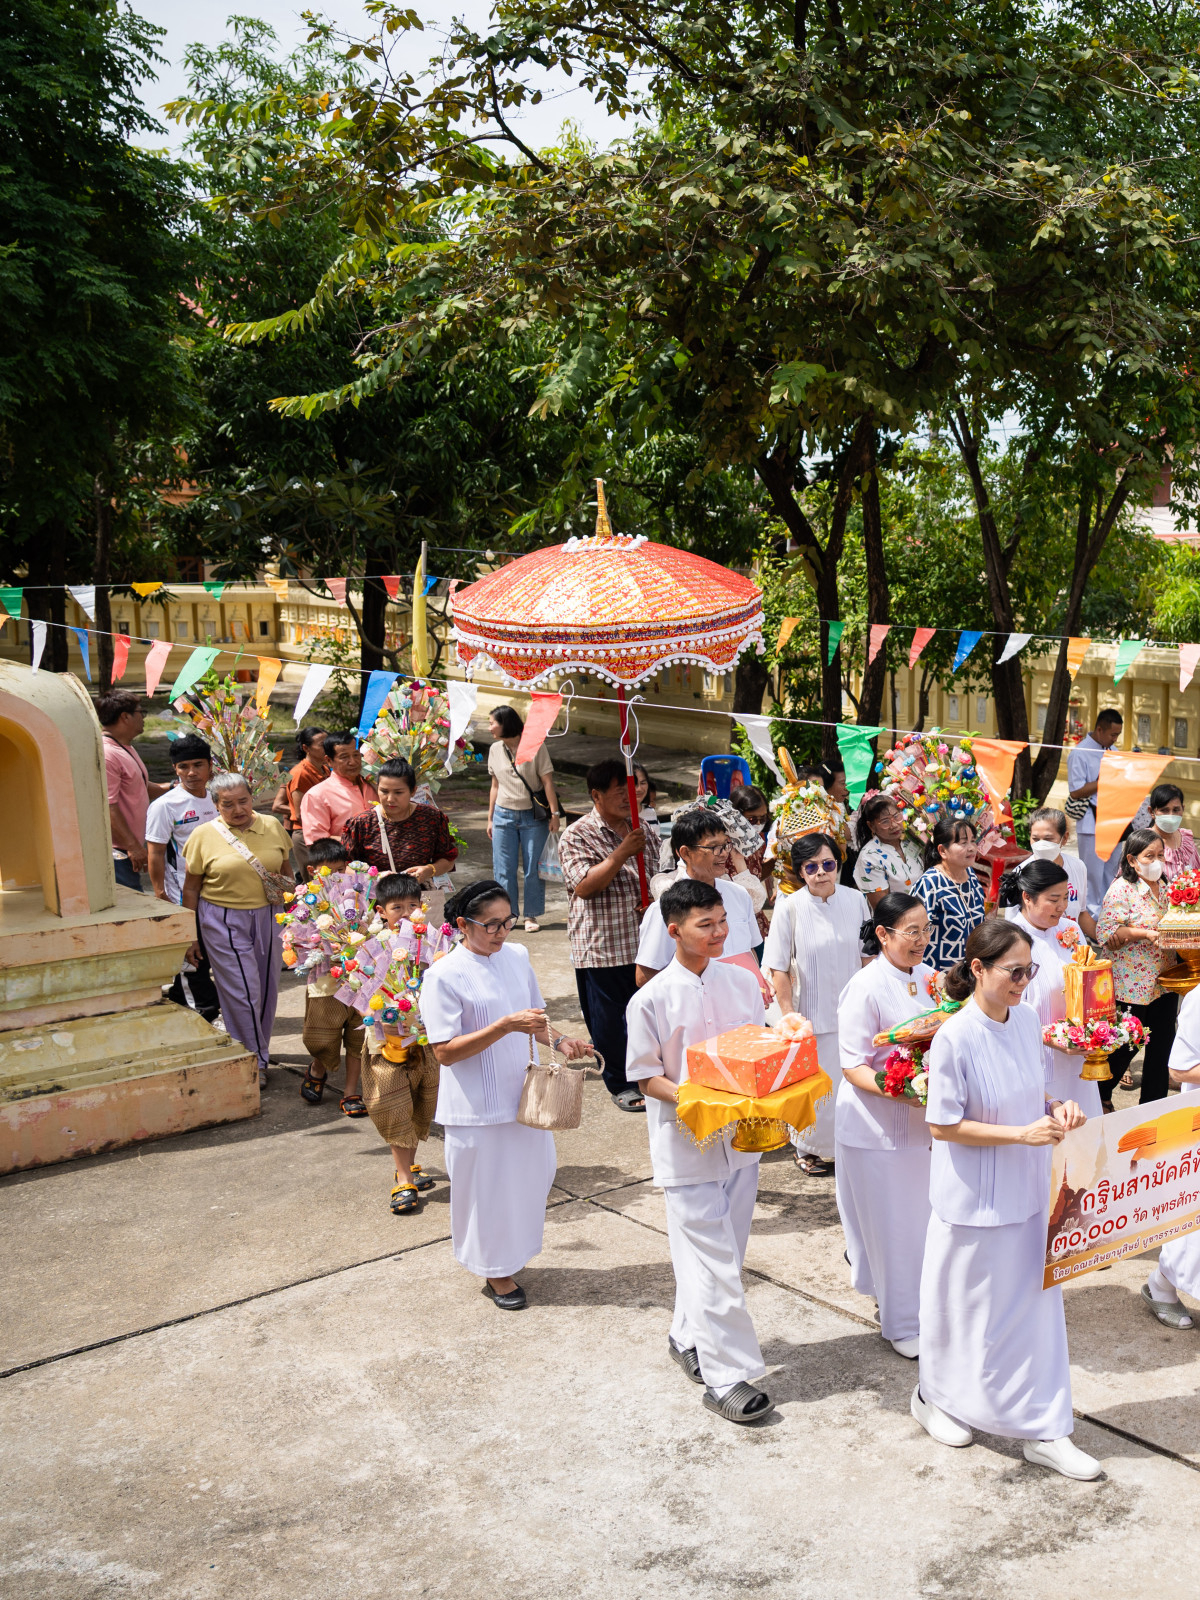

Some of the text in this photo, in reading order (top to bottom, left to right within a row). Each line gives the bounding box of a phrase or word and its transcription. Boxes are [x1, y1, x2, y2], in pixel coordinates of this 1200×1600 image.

[1053, 1268, 1070, 1280] โดย
[1143, 1226, 1179, 1249] บูชาธรรม
[1054, 1215, 1128, 1253] ๓๐,๐๐๐
[1133, 1207, 1148, 1224] วัด
